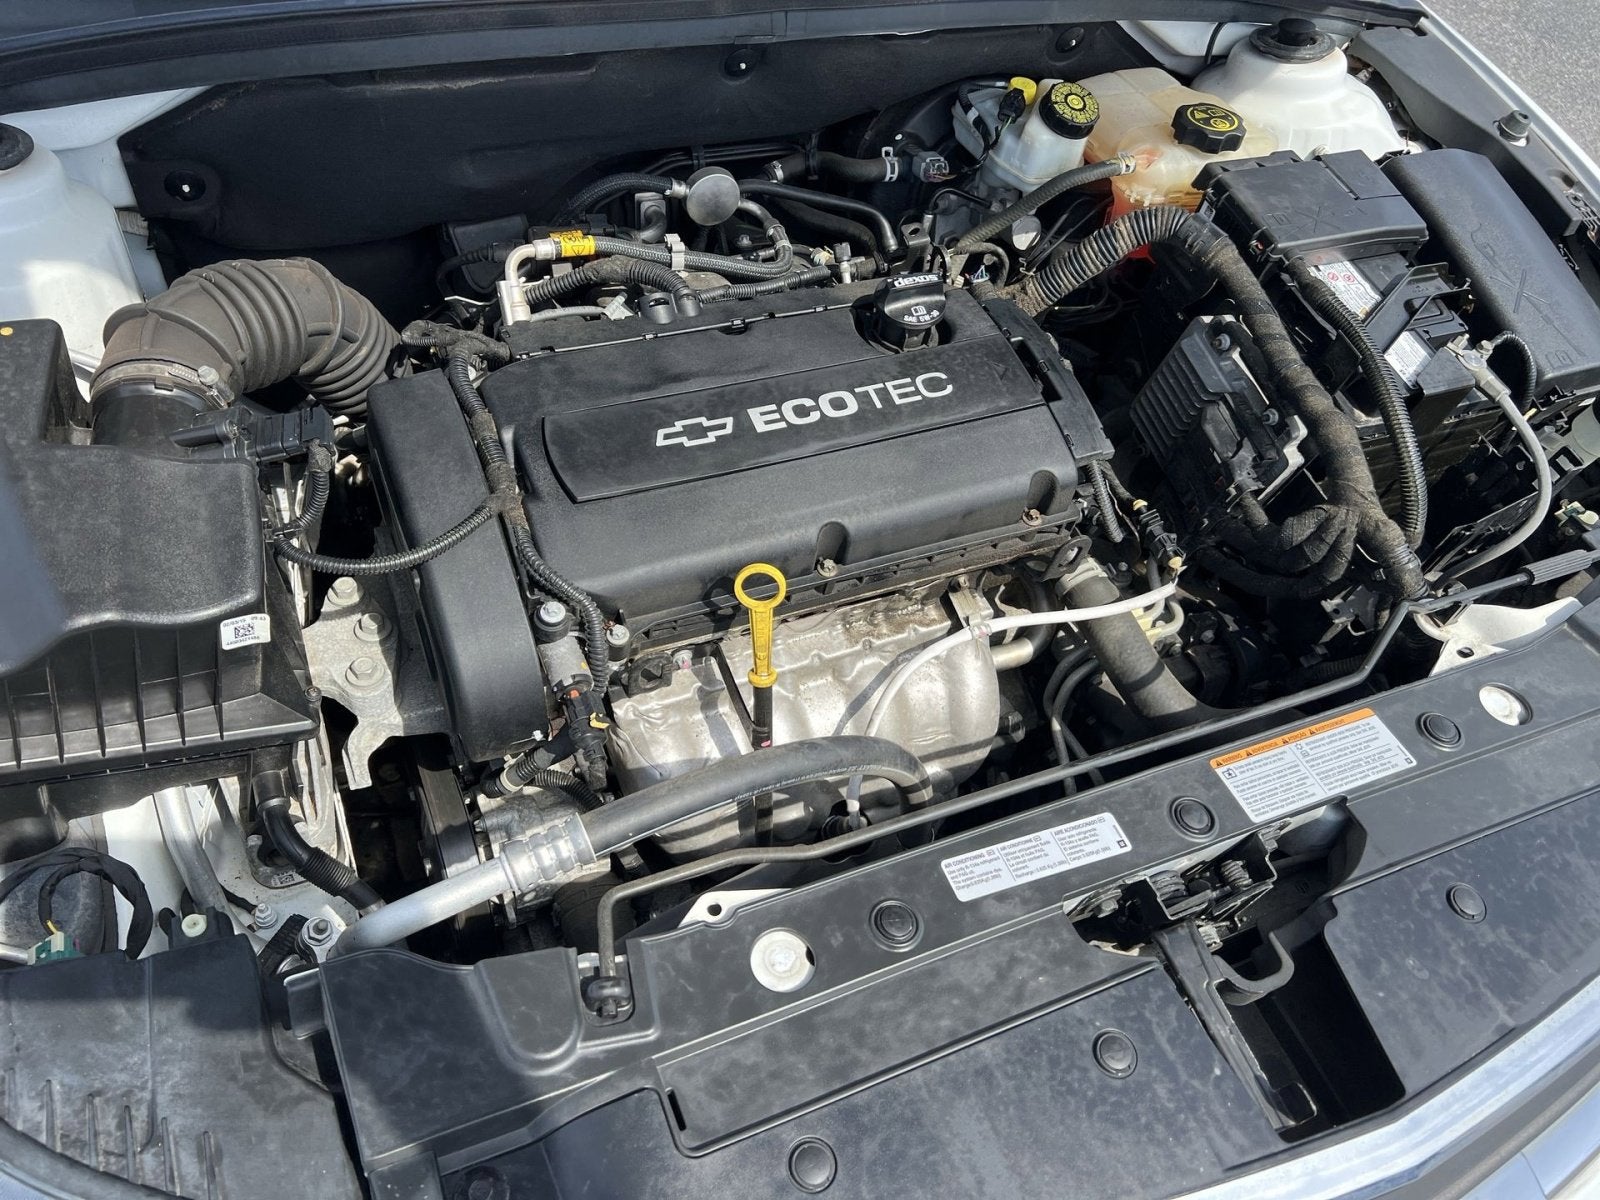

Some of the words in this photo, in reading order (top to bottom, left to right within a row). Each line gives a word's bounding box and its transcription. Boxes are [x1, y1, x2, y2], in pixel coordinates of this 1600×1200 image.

[894, 274, 938, 288] dexos
[904, 314, 918, 323] SAE
[919, 309, 940, 323] 5W-30
[746, 371, 953, 433] ECOTEC
[951, 853, 985, 866] CONDITIONING
